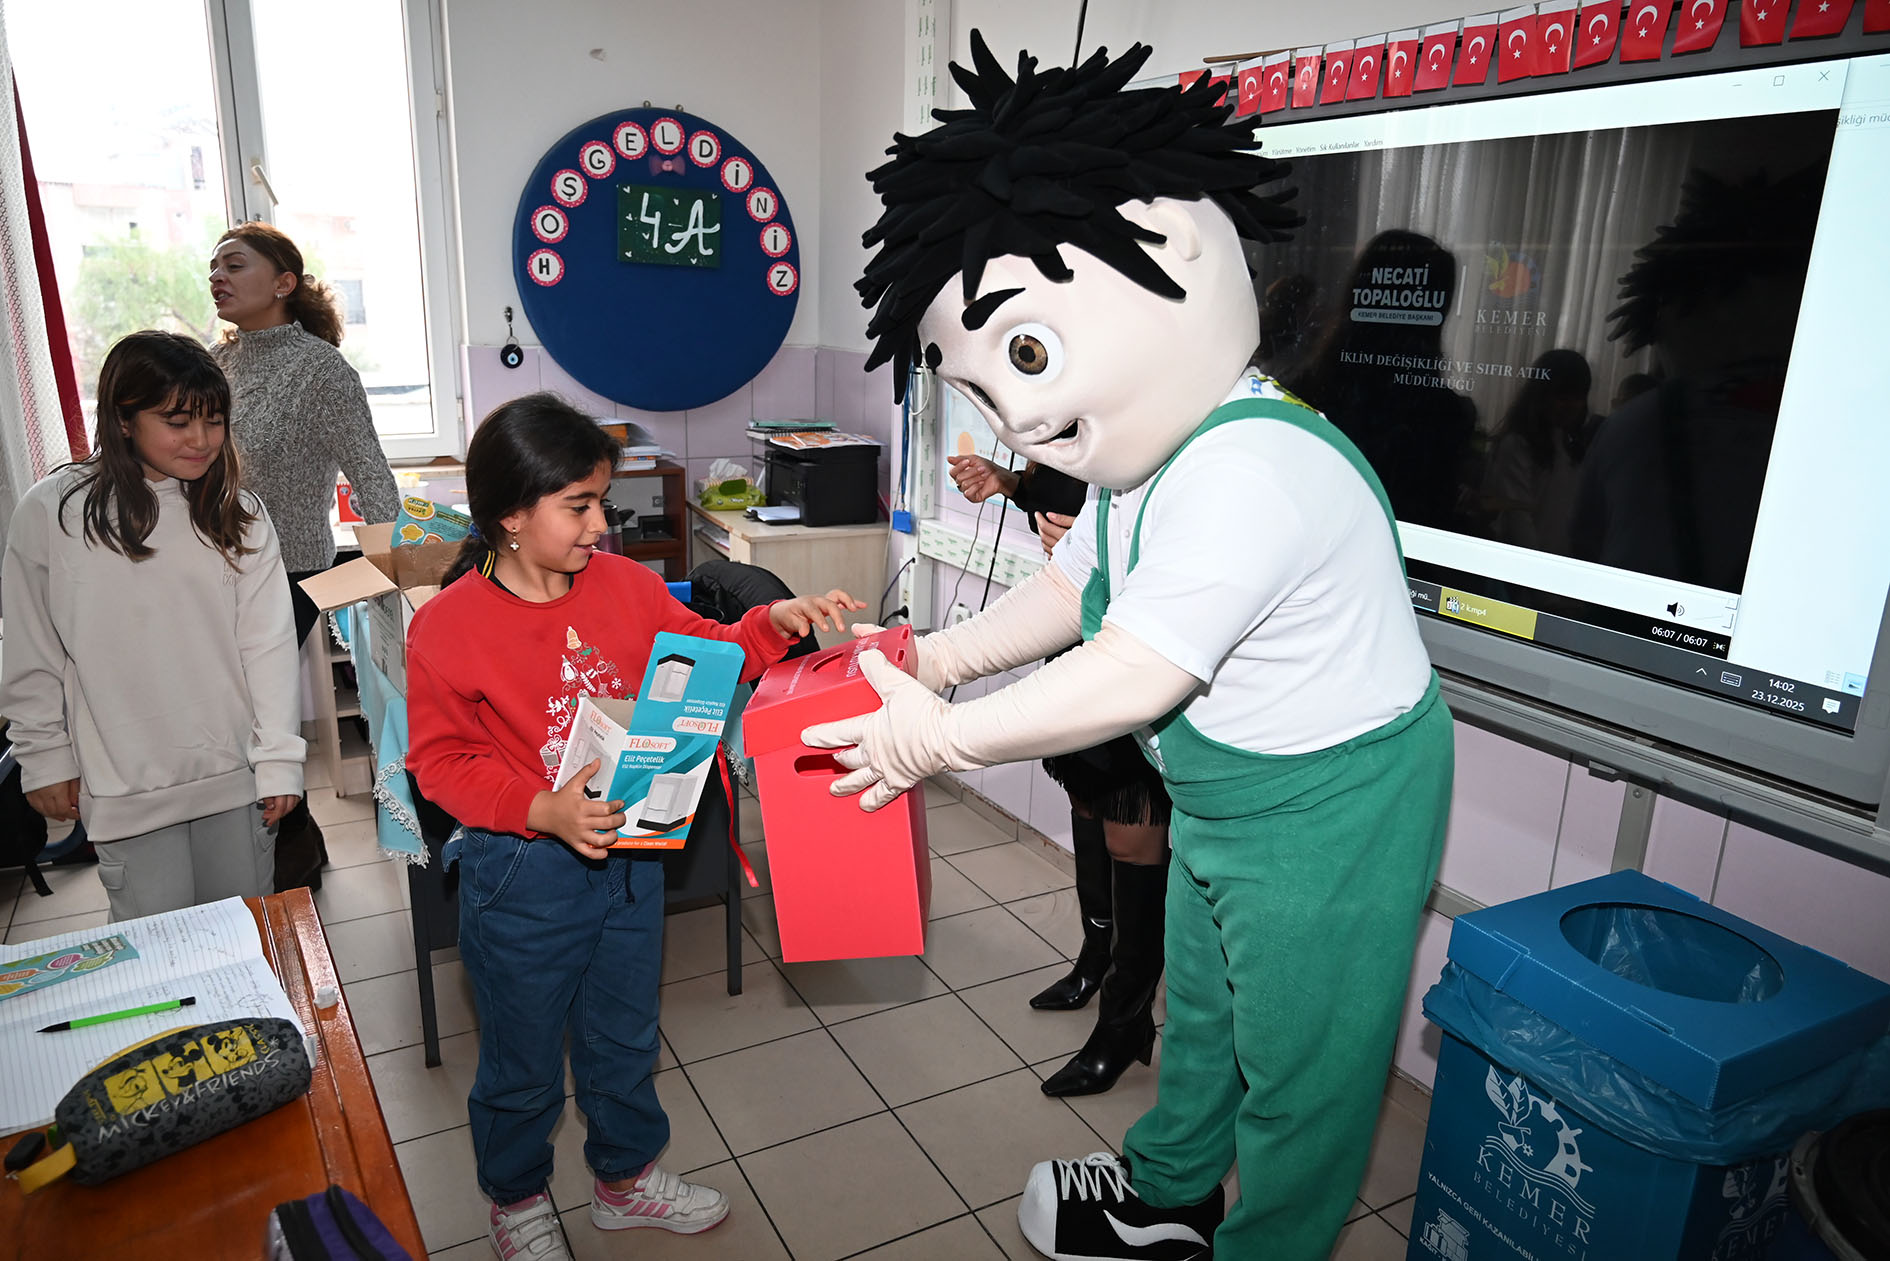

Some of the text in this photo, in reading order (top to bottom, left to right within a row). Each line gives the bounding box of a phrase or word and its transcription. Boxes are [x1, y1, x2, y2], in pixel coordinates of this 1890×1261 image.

[1371, 263, 1429, 285] NECATİ
[1352, 286, 1446, 309] TOPALOĞLU
[1476, 309, 1548, 327] KEMER
[1340, 349, 1552, 381] İKLİM DEĞİŞİKLİĞİ VE SIFIR ATIK
[1393, 371, 1476, 392] MÜDÜRLÜĞÜ
[1651, 626, 1676, 639] 06:07
[1683, 634, 1708, 647] 06:07
[1768, 678, 1795, 693] 14:02
[1751, 689, 1805, 712] 23.12.2025
[711, 707, 724, 716] Elit
[624, 755, 665, 764] Elit Peçetelik
[1428, 1171, 1463, 1204] YALNIZCA
[1463, 1202, 1482, 1221] GERİ
[1476, 1144, 1592, 1245] KEMER
